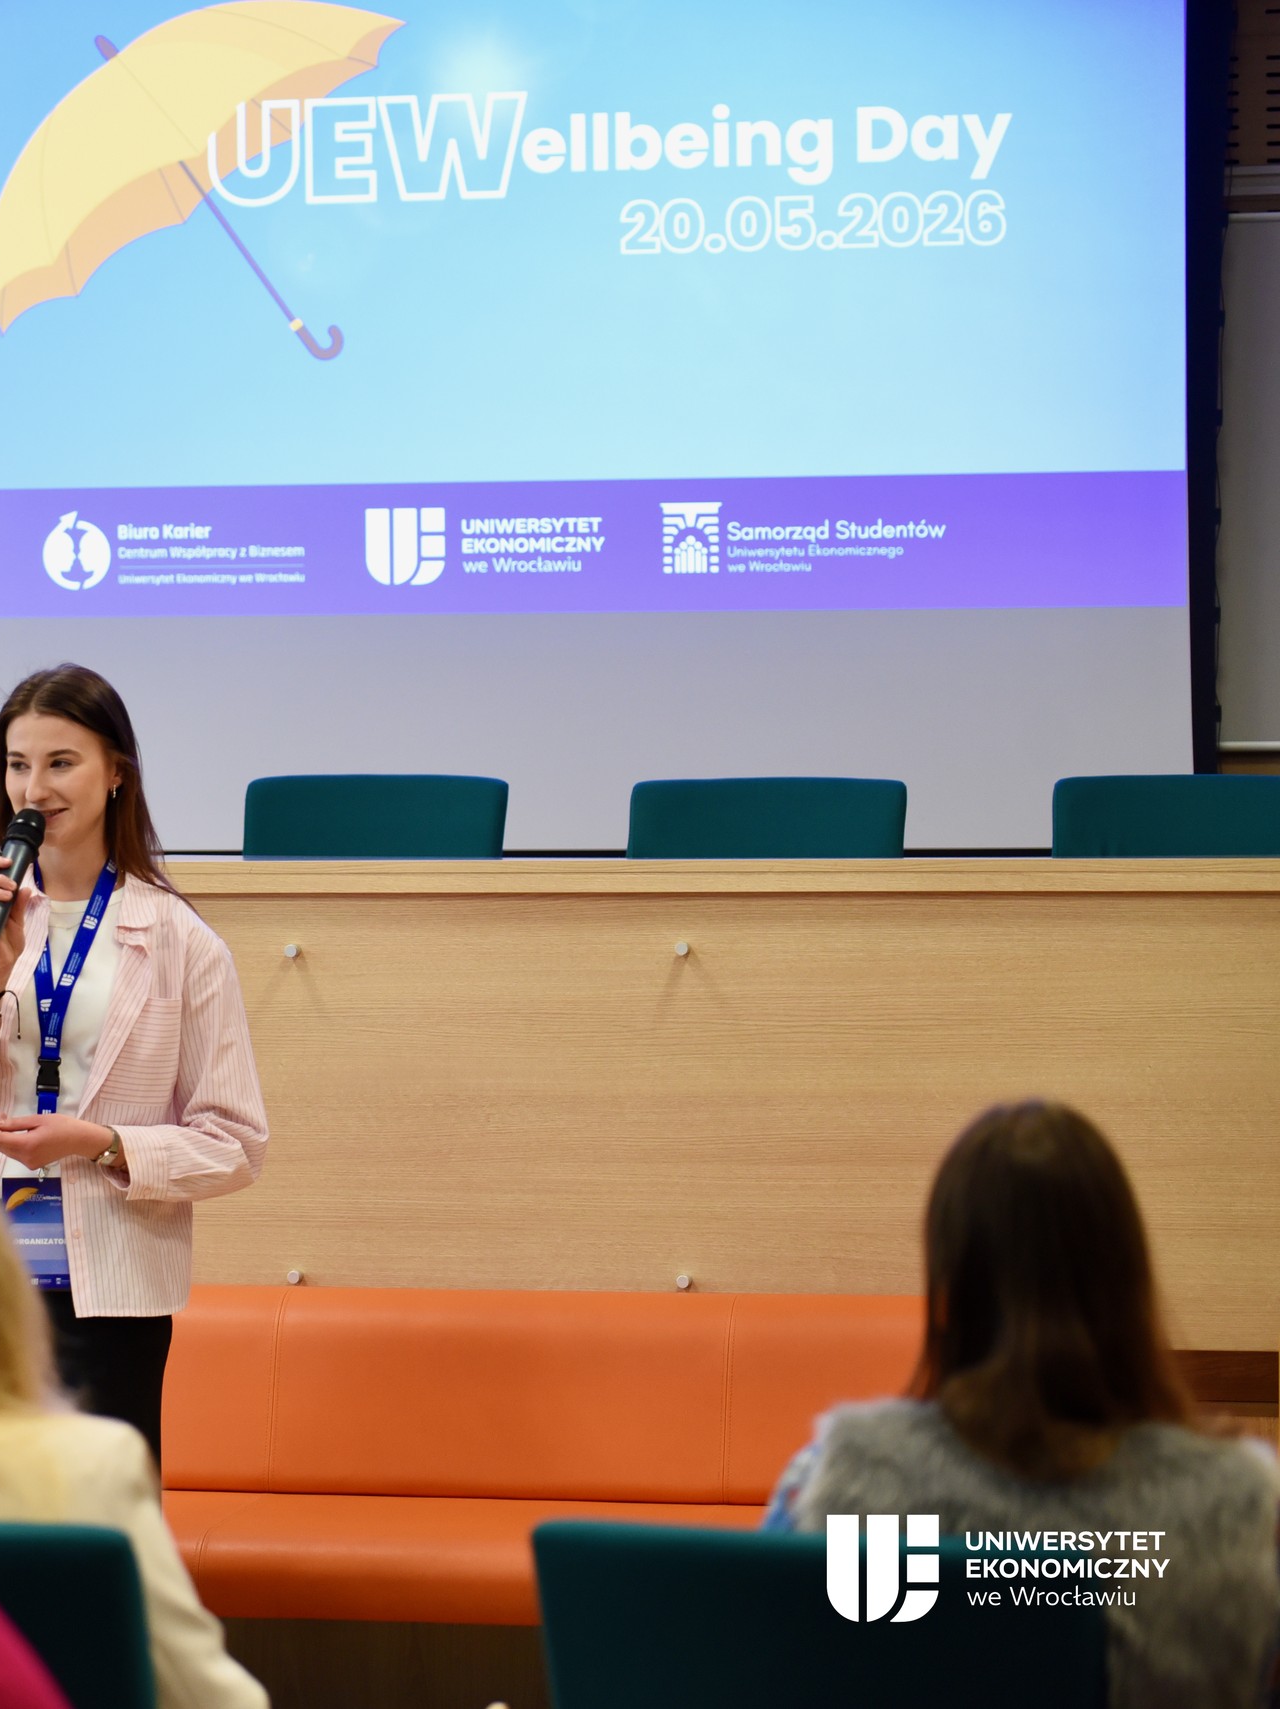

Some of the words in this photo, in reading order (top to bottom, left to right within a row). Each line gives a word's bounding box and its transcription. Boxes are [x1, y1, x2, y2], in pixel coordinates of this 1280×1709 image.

[207, 90, 834, 207] UEWellbeing
[856, 105, 1013, 180] Day
[619, 190, 1007, 255] 20.05.2026
[117, 524, 159, 540] Biuro
[162, 522, 212, 539] Karier
[461, 517, 602, 534] UNIWERSYTET
[726, 518, 829, 542] Samorząd
[835, 518, 946, 540] Studentów
[118, 547, 168, 559] Centrum
[169, 545, 237, 560] Współpracy
[249, 545, 305, 557] Biznesem
[461, 536, 605, 554] EKONOMICZNY
[727, 545, 805, 559] Uniwersytetu
[808, 544, 904, 559] Ekonomicznego
[462, 560, 488, 573] we
[492, 556, 582, 573] Wrocławiu
[727, 562, 746, 573] we
[749, 560, 812, 573] Wrocławiu
